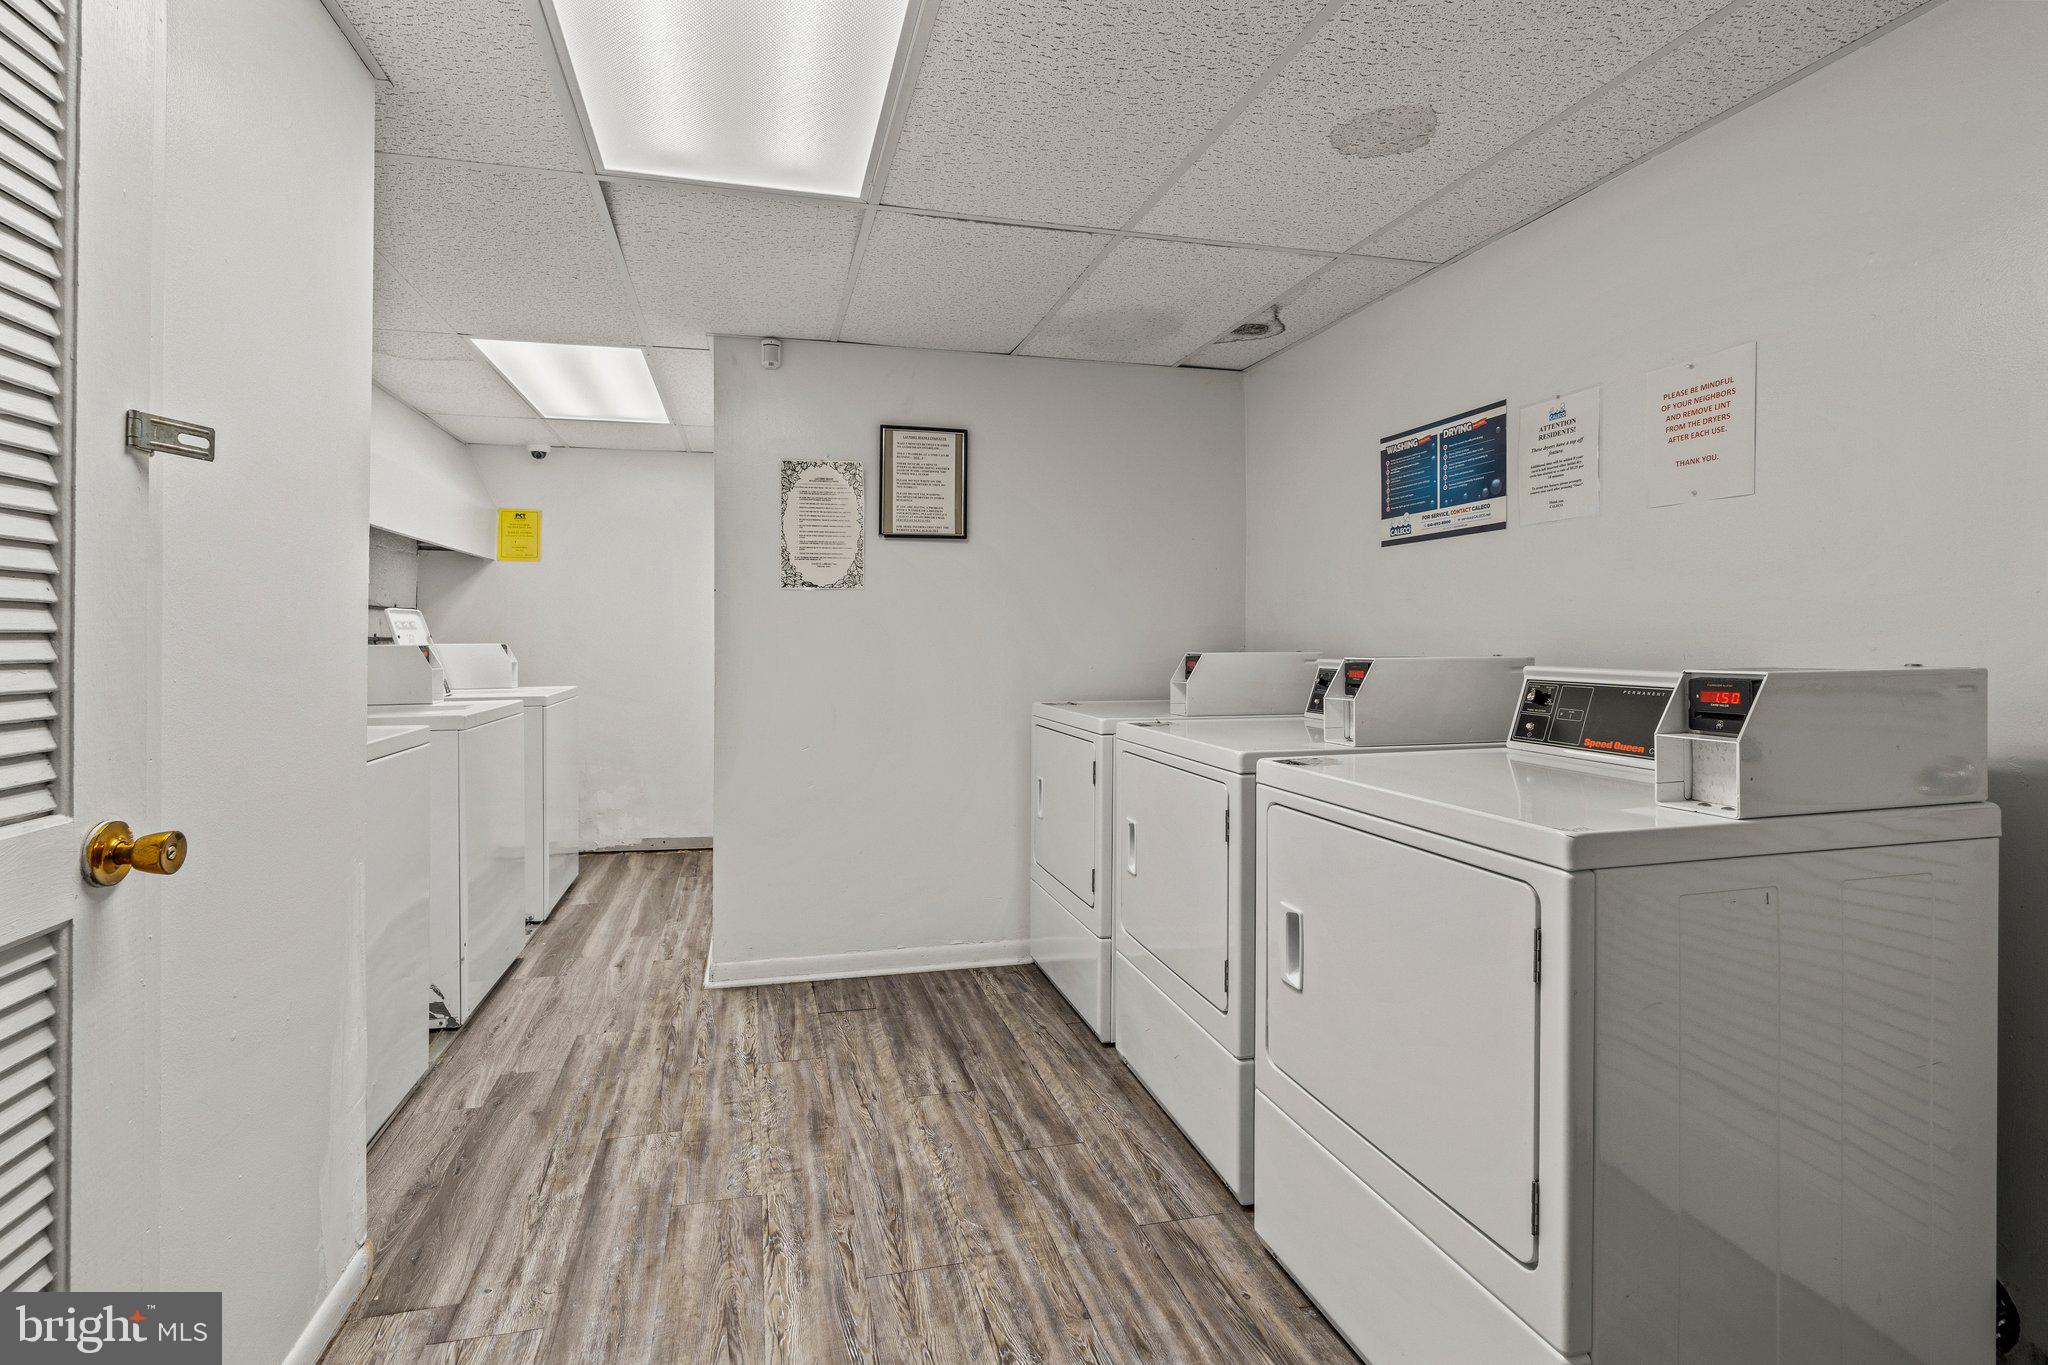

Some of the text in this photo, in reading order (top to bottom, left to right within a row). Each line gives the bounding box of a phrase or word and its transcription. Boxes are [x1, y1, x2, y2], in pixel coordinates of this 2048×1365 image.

[1664, 389, 1688, 400] PLEASE
[1700, 377, 1734, 391] MINDFUL
[1673, 399, 1693, 409] YOUR
[1694, 388, 1736, 404] NEIGHBORS
[1665, 401, 1731, 422] AND REMOVE LINT
[1442, 422, 1472, 438] DRYING
[1539, 418, 1576, 432] ATTENTION
[1665, 412, 1731, 433] FROM THE DRYERS
[1538, 426, 1576, 441] RESIDENTS!
[1668, 425, 1728, 444] AFTER EACH USE.
[1386, 438, 1418, 455] WASHING
[1675, 454, 1719, 467] THANK YOU.
[1450, 506, 1471, 516] CONTACT
[1471, 503, 1491, 512] CALECO
[1390, 526, 1411, 536] CALECO
[1584, 738, 1612, 750] Speed
[1614, 740, 1645, 753] Queen
